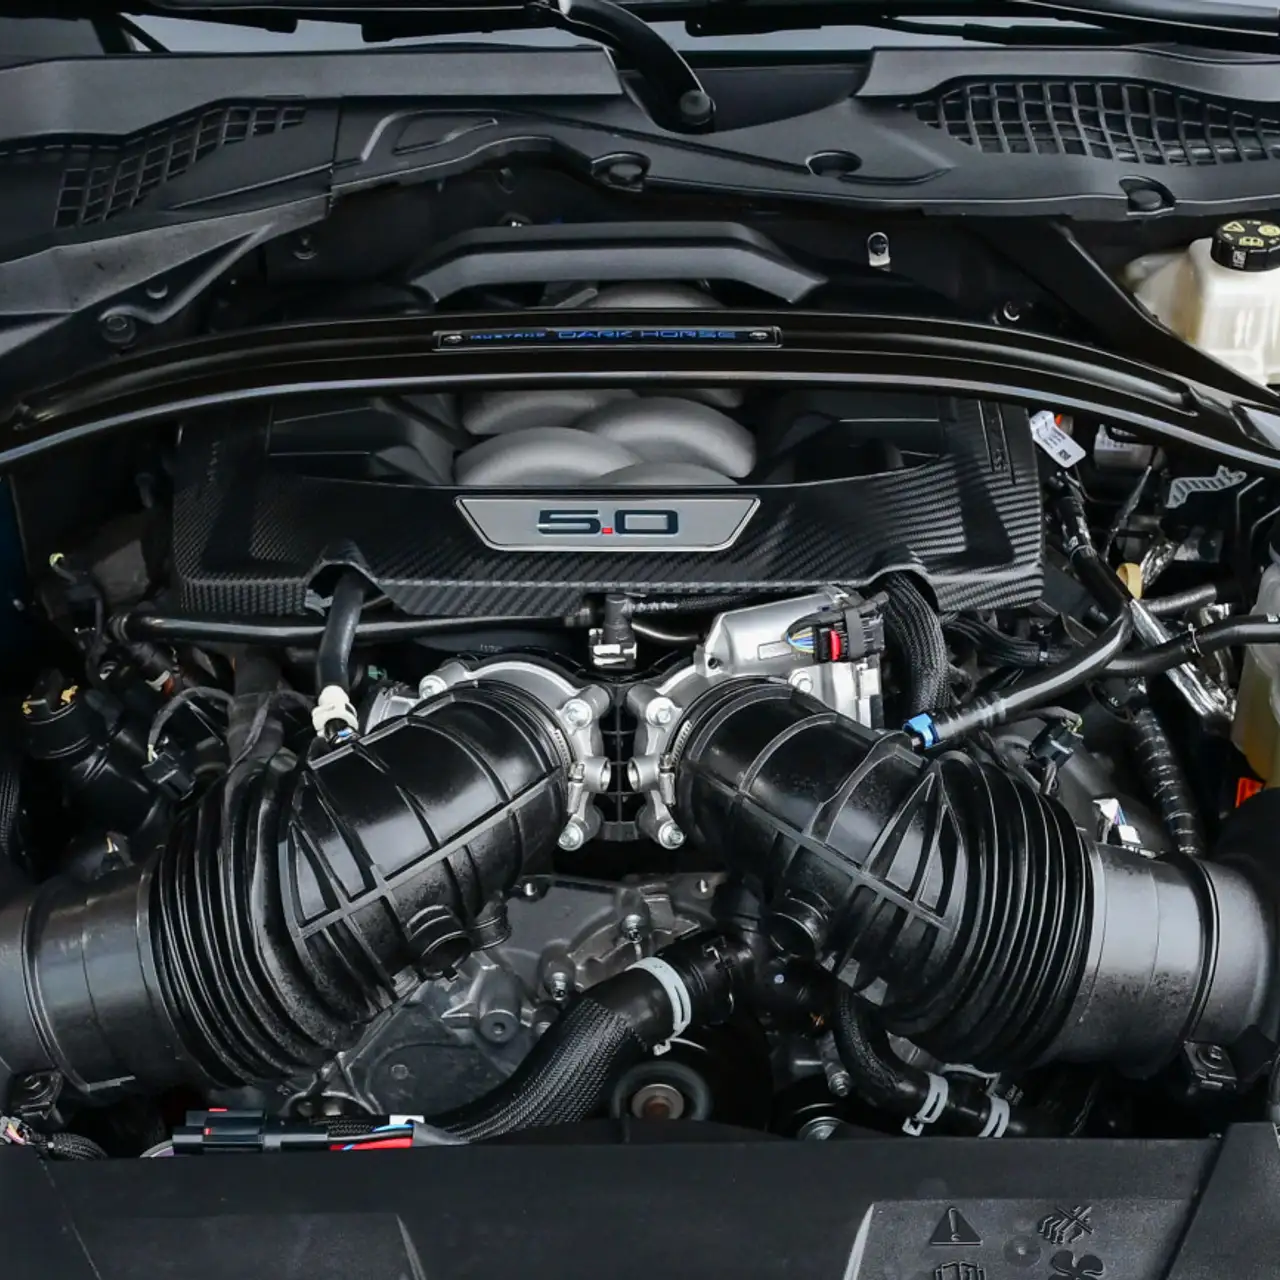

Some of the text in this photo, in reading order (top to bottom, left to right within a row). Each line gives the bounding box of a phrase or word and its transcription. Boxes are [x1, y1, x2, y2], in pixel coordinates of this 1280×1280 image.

[557, 330, 632, 339] DARK
[640, 329, 736, 339] HORSE
[538, 509, 679, 535] 5.0
